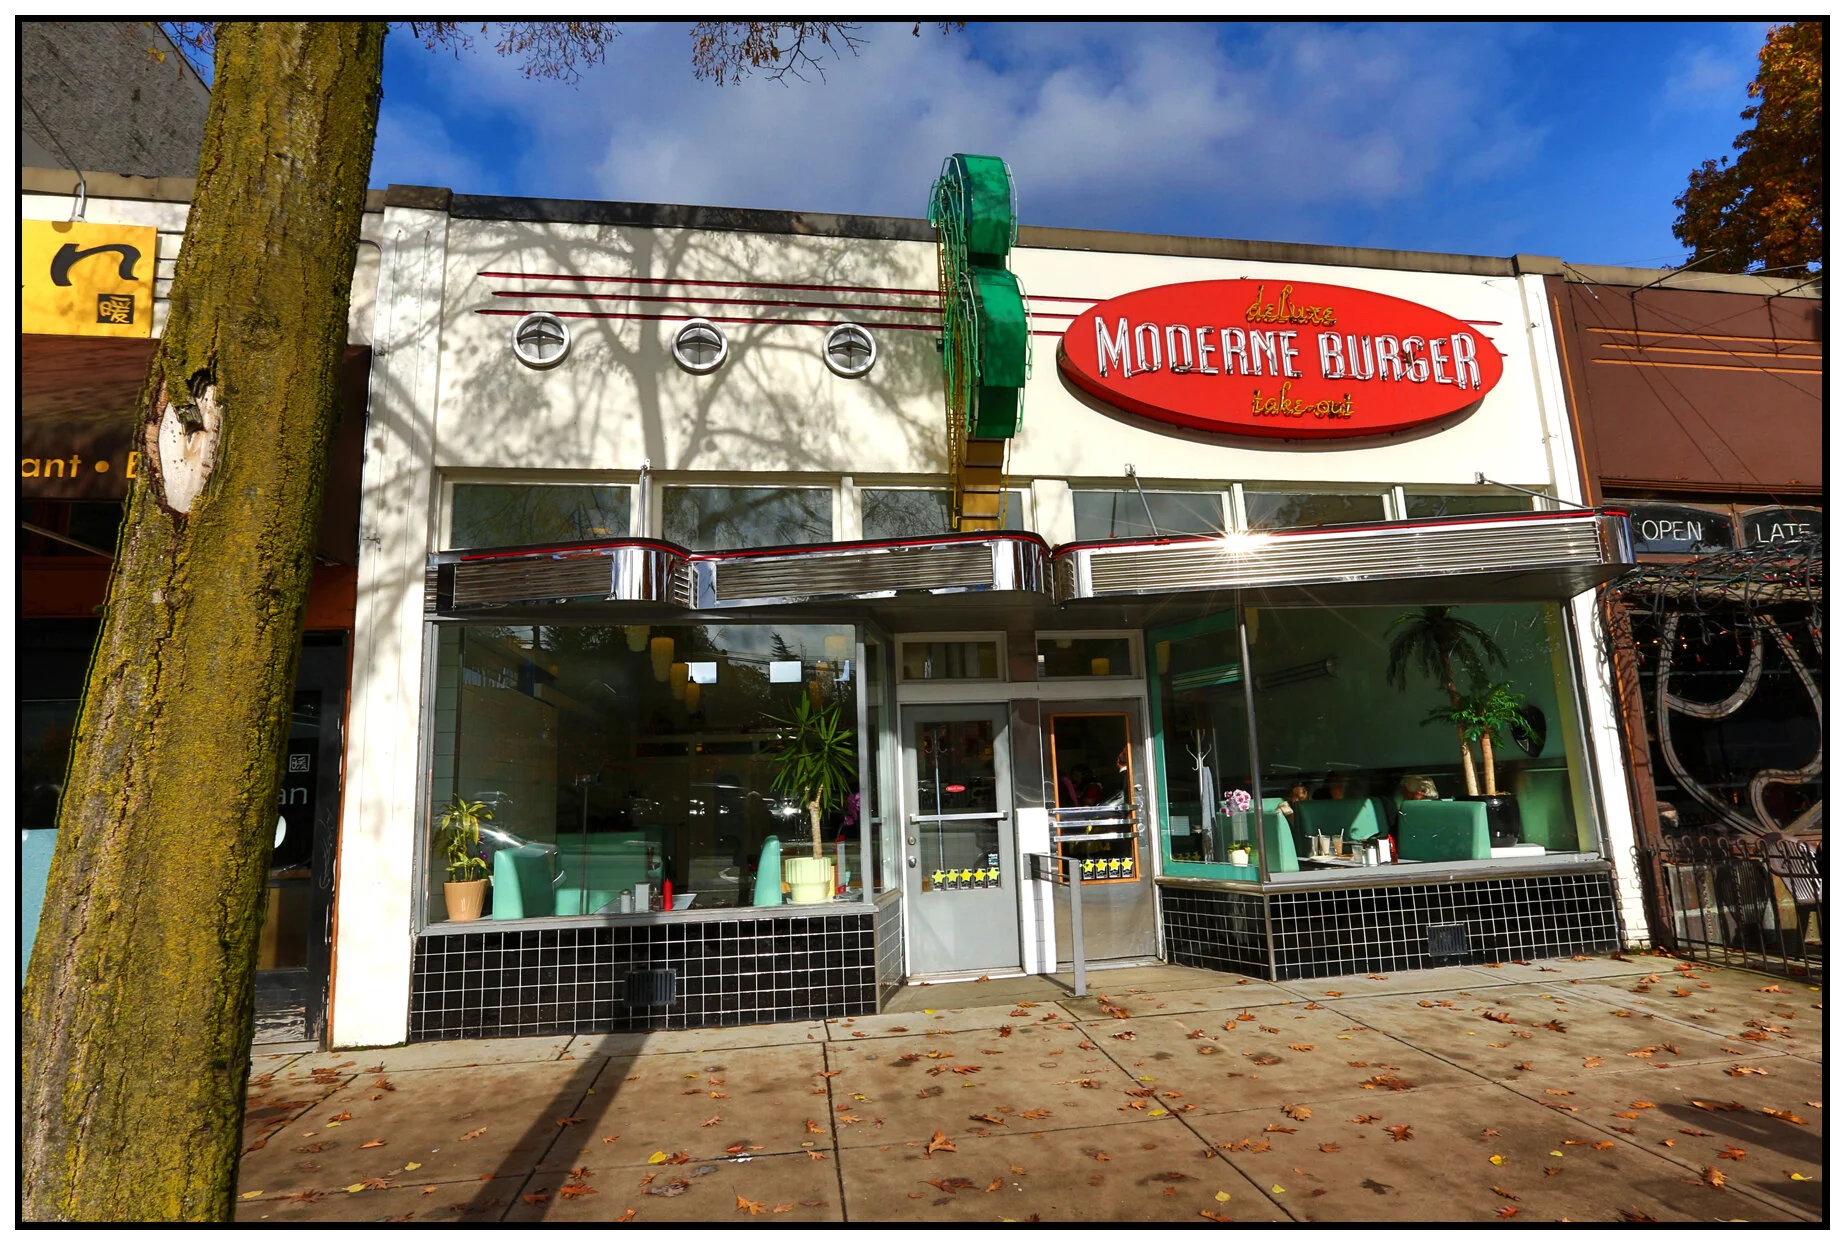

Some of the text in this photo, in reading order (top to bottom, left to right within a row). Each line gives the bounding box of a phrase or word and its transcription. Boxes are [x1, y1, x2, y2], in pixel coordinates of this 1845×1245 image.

[1094, 316, 1482, 391] MODERNE BURGER
[1252, 381, 1355, 417] take-out
[1641, 519, 1702, 541] OPEN
[1755, 522, 1811, 543] LATE
